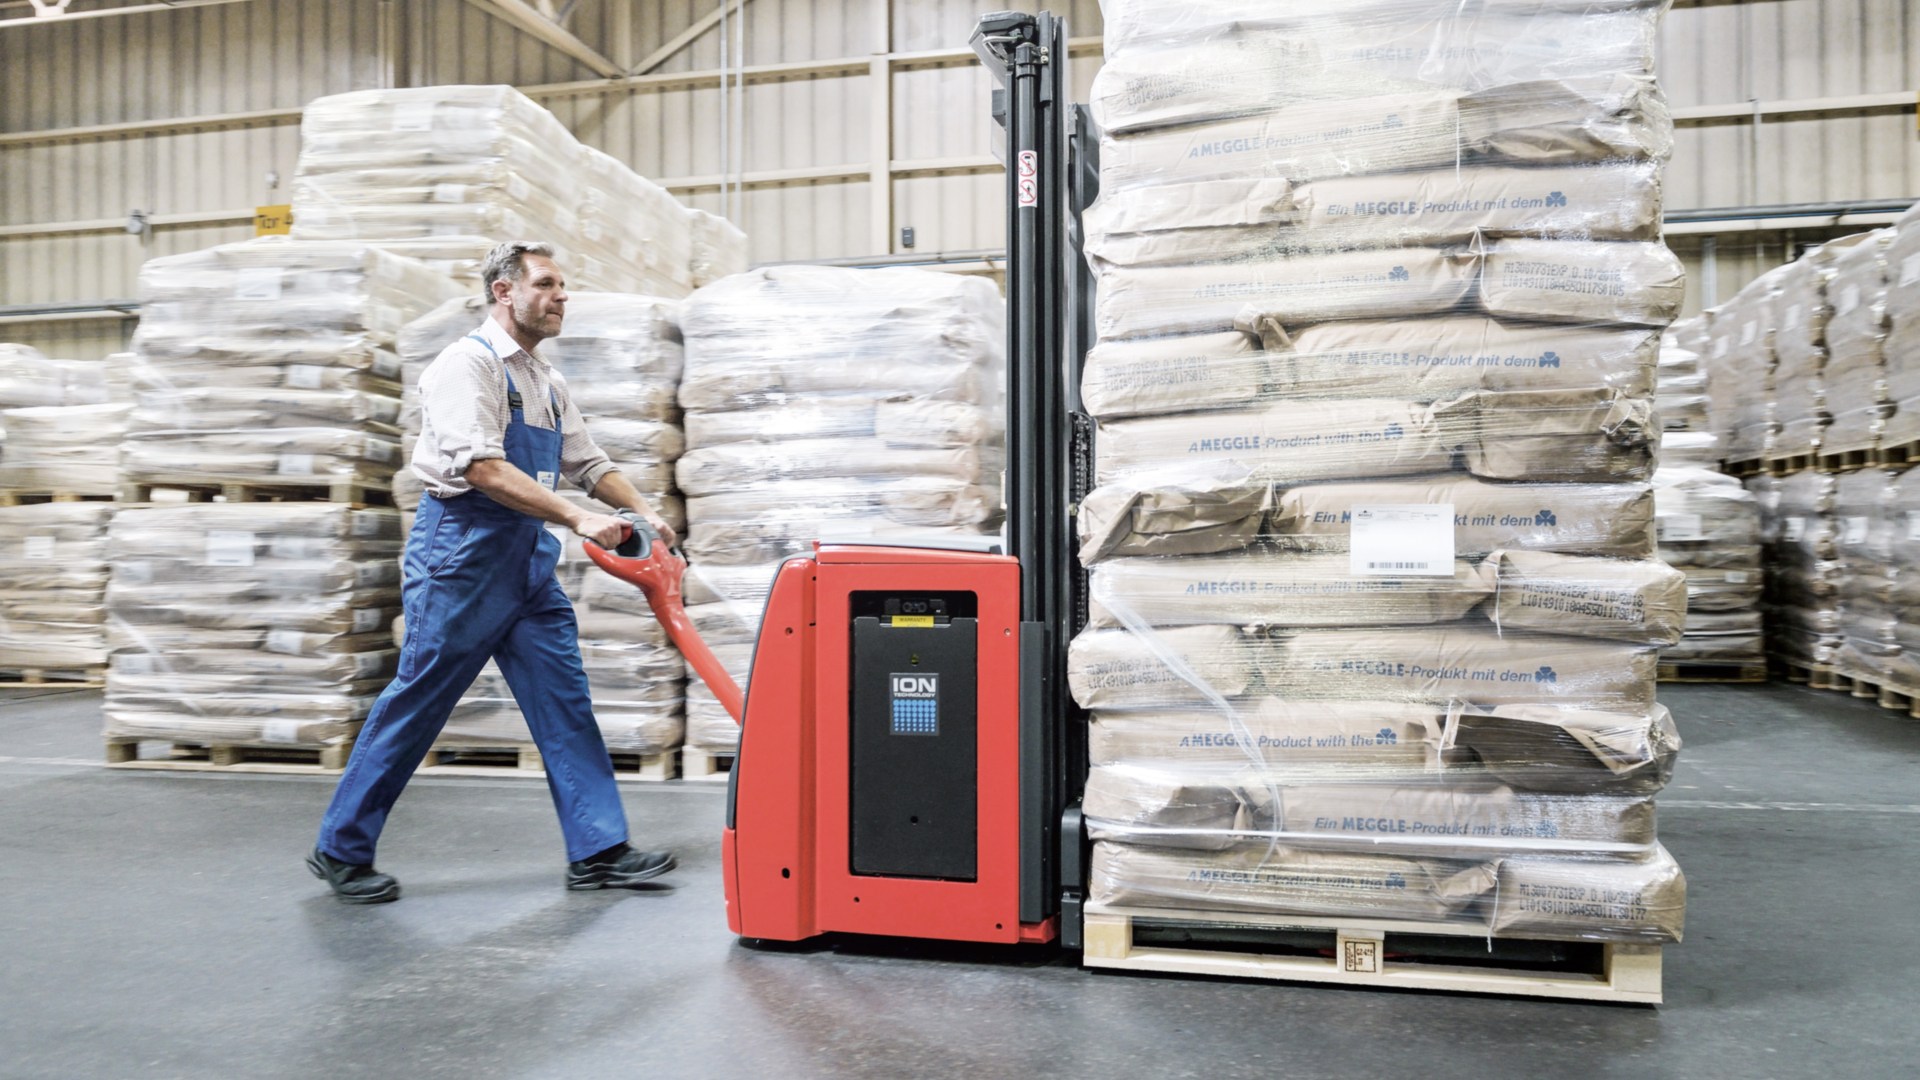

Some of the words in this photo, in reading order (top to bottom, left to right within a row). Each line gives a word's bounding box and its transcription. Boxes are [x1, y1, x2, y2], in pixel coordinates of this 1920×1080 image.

[1326, 203, 1349, 216] Ein
[1483, 198, 1507, 210] mit
[1511, 196, 1542, 209] dem
[1477, 353, 1500, 366] mit
[1504, 353, 1537, 368] dem
[1188, 441, 1198, 453] A
[1313, 511, 1337, 523] Ein
[1472, 513, 1495, 527] mit
[1500, 513, 1533, 527] dem
[1472, 668, 1495, 681] mit
[1500, 669, 1533, 683] dem
[893, 677, 937, 693] ION
[1179, 736, 1190, 747] A
[1316, 735, 1346, 747] with
[1351, 734, 1374, 747] the
[1314, 817, 1337, 829] Ein
[1472, 824, 1496, 836] mit
